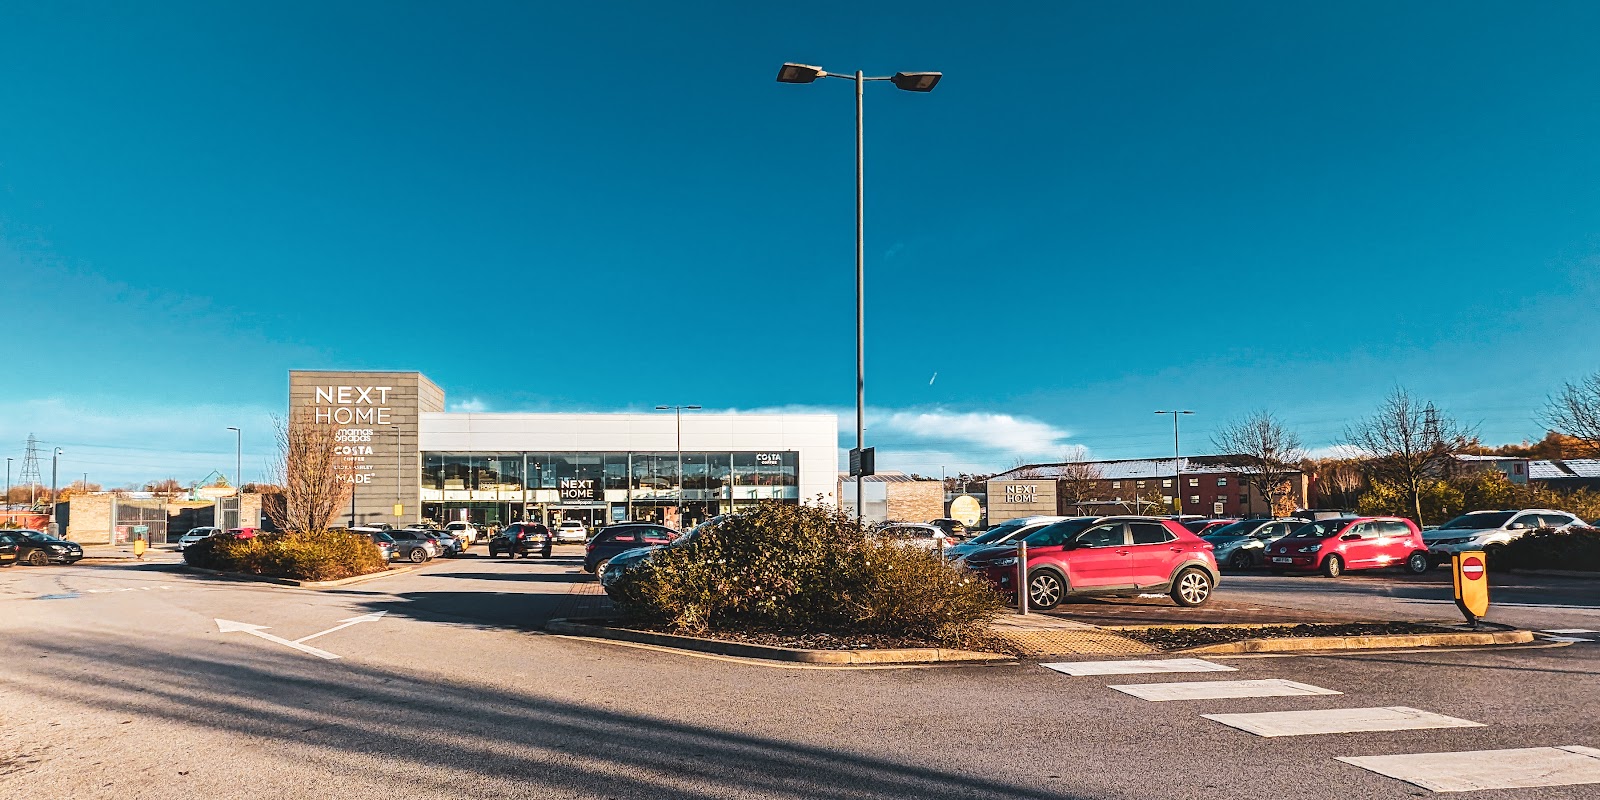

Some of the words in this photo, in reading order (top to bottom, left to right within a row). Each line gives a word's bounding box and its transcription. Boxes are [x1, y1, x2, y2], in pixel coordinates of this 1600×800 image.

[315, 386, 392, 404] NEXT
[315, 407, 391, 424] HOME
[337, 428, 374, 436] mamas
[334, 446, 374, 455] COSTA
[756, 453, 781, 461] COSTA
[561, 479, 594, 489] NEXT
[1006, 484, 1038, 493] NEXT
[561, 489, 594, 498] HOME
[1006, 494, 1038, 502] HOME
